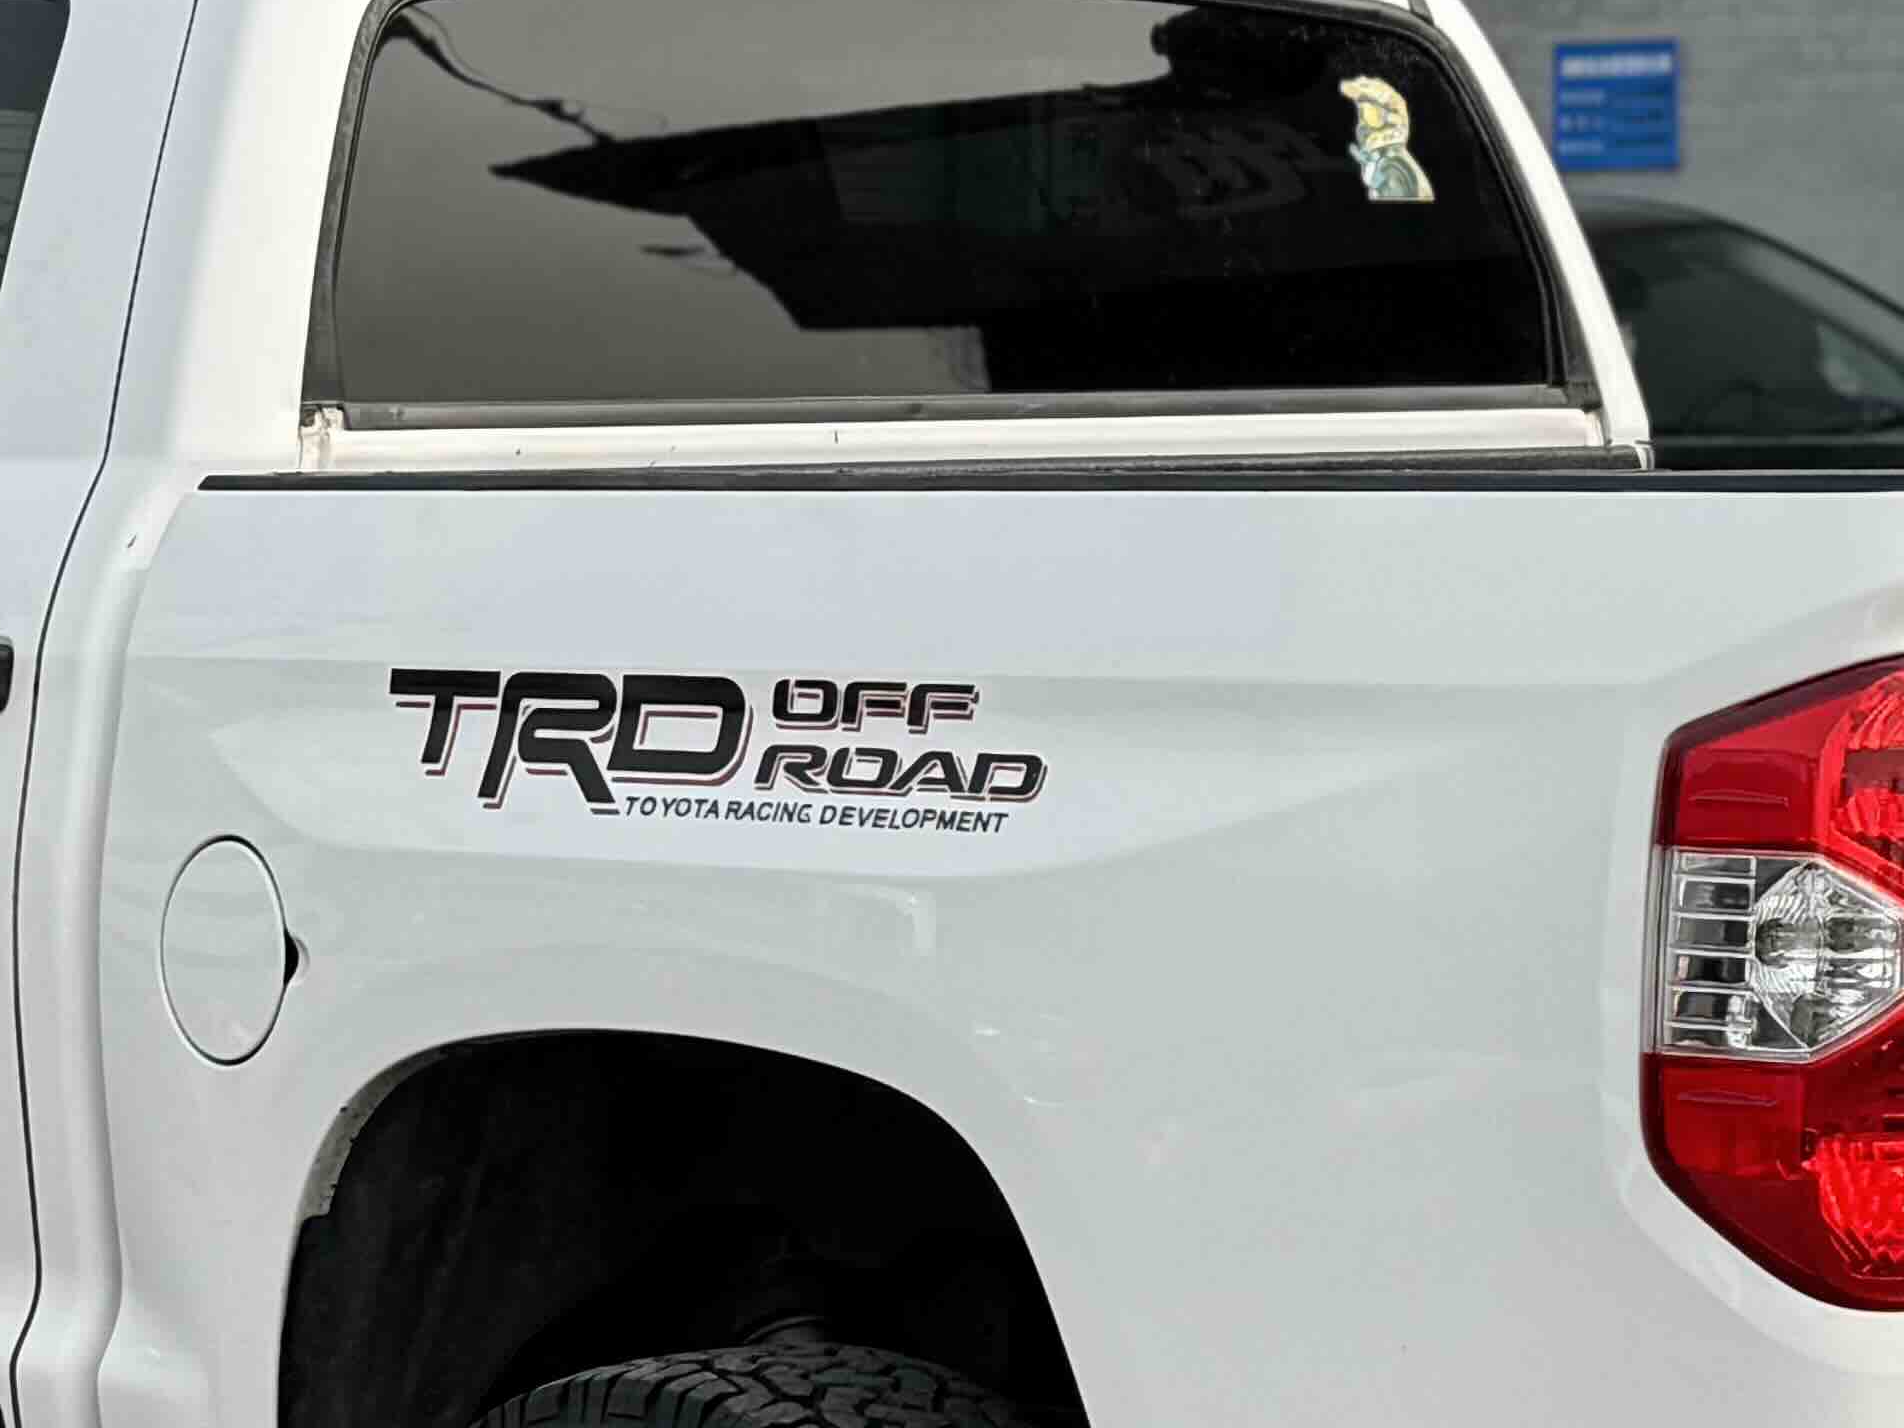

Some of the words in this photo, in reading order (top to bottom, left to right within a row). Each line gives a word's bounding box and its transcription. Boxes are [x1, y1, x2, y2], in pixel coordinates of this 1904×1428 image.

[771, 677, 981, 733] OFF
[389, 667, 754, 815] TRD
[753, 744, 1048, 802] ROAD
[623, 796, 722, 820] TOYOTA
[724, 799, 812, 825] RACING
[819, 805, 1009, 834] DEVELOPMENT
